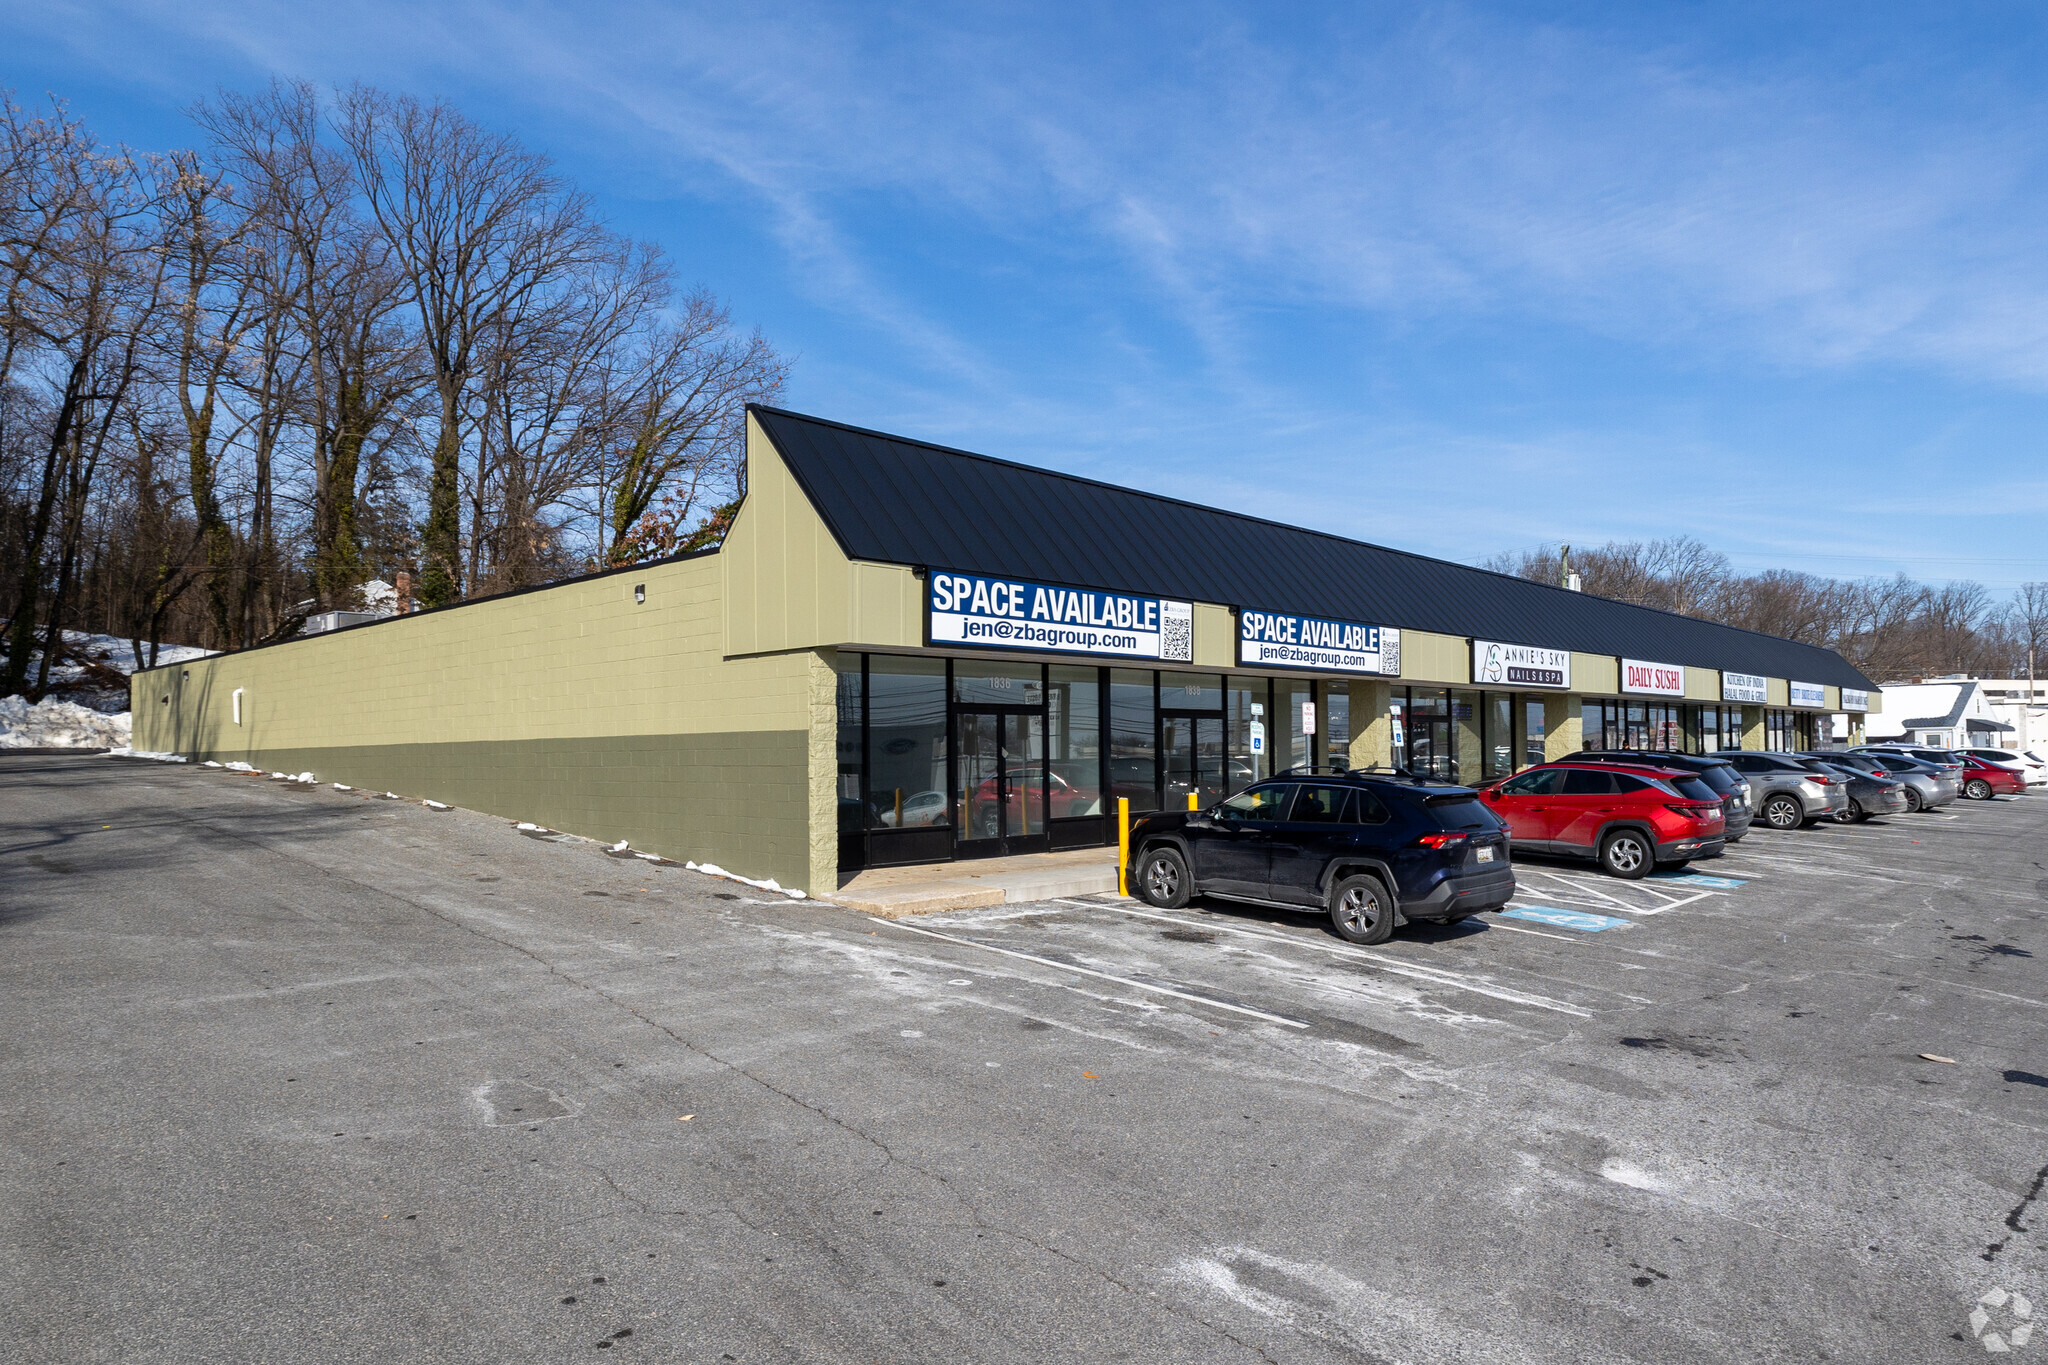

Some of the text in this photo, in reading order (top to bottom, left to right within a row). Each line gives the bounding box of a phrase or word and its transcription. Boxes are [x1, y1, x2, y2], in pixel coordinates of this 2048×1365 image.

[933, 575, 1157, 631] SPACE AVAILABLE
[961, 618, 1137, 648] jen@zbagroup.com
[1242, 611, 1378, 652] SPACE AVAILABLE
[1259, 644, 1365, 666] jen@zbagroup.com
[1504, 647, 1565, 667] ANNIE'S SKY
[989, 677, 1011, 689] 1836
[1510, 669, 1537, 681] NAILS
[1545, 671, 1561, 683] SPA
[1628, 665, 1680, 690] DAILY SUSHI
[1739, 689, 1750, 700] FOOD
